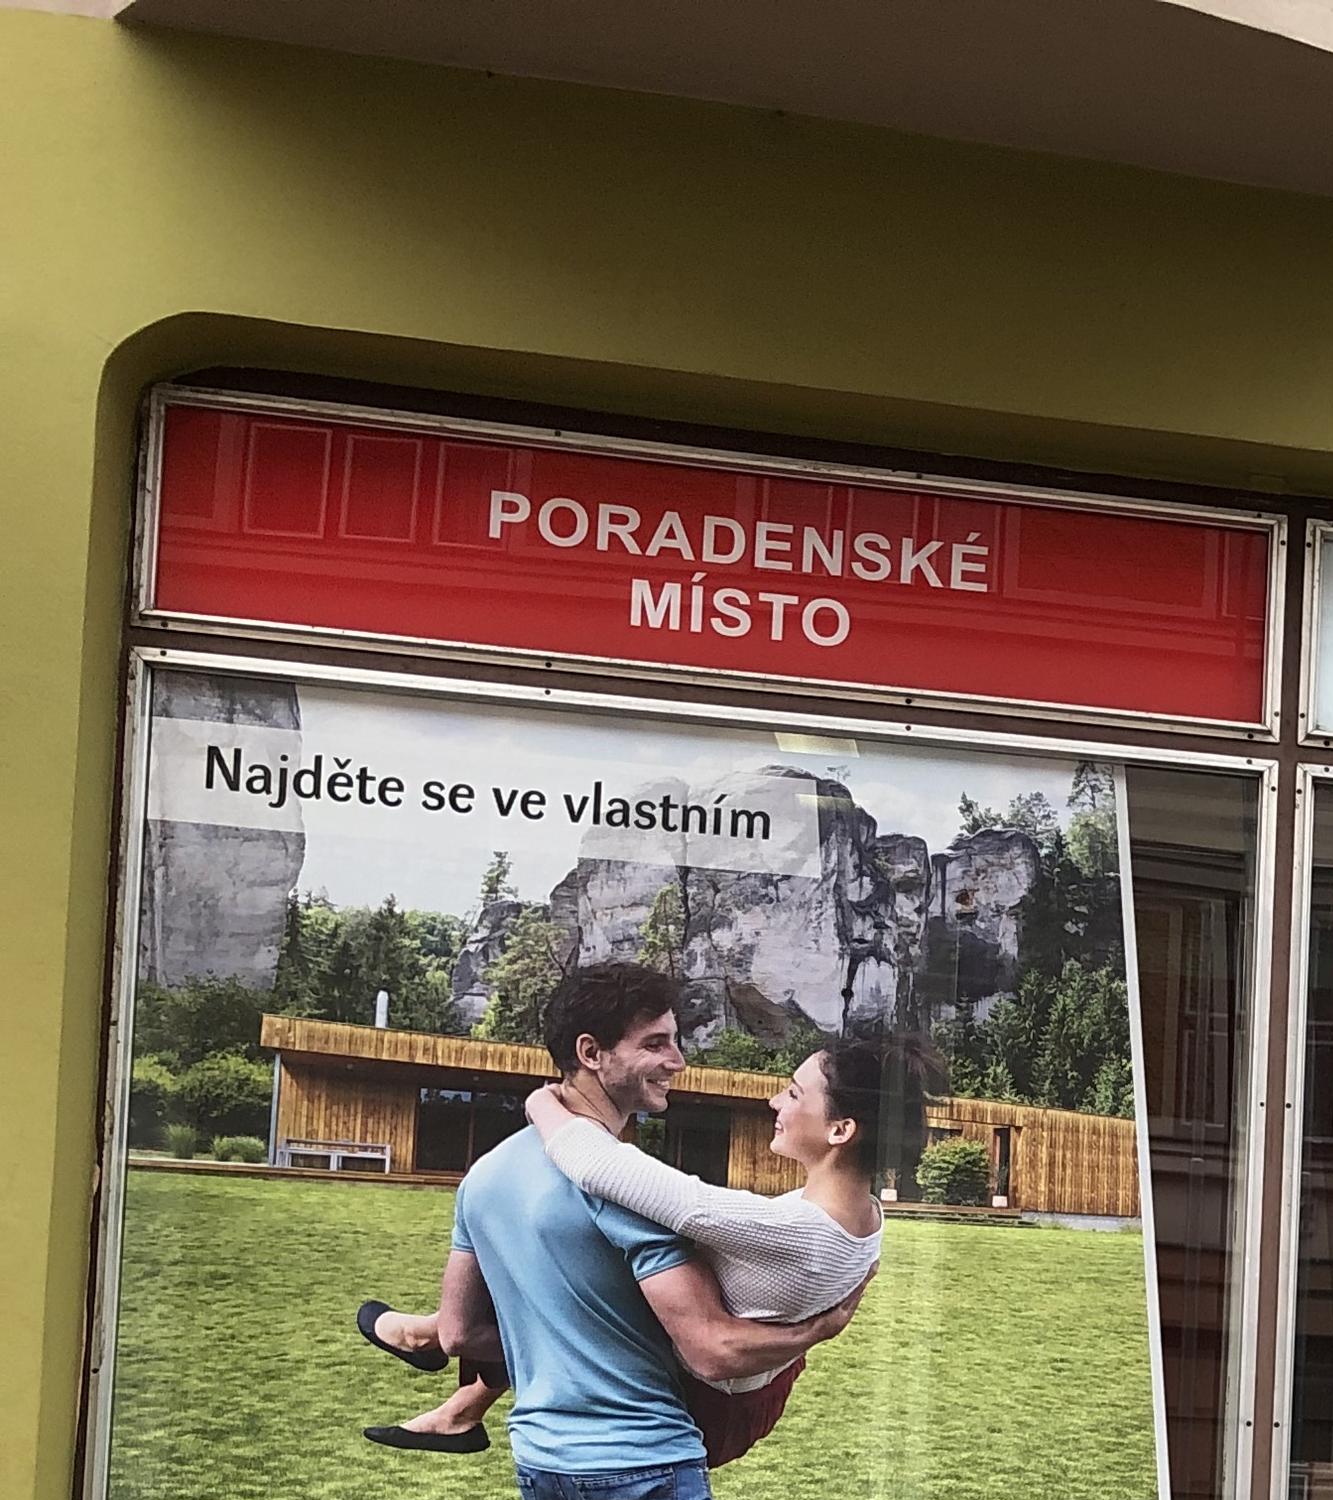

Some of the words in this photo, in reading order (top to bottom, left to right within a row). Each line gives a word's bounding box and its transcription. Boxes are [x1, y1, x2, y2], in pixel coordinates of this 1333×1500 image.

[488, 490, 989, 593] PORADENSKÉ
[630, 571, 850, 647] MÍSTO
[205, 744, 405, 810] Najděte
[421, 781, 475, 814] se
[492, 787, 546, 820] ve
[563, 781, 771, 840] vlastním
